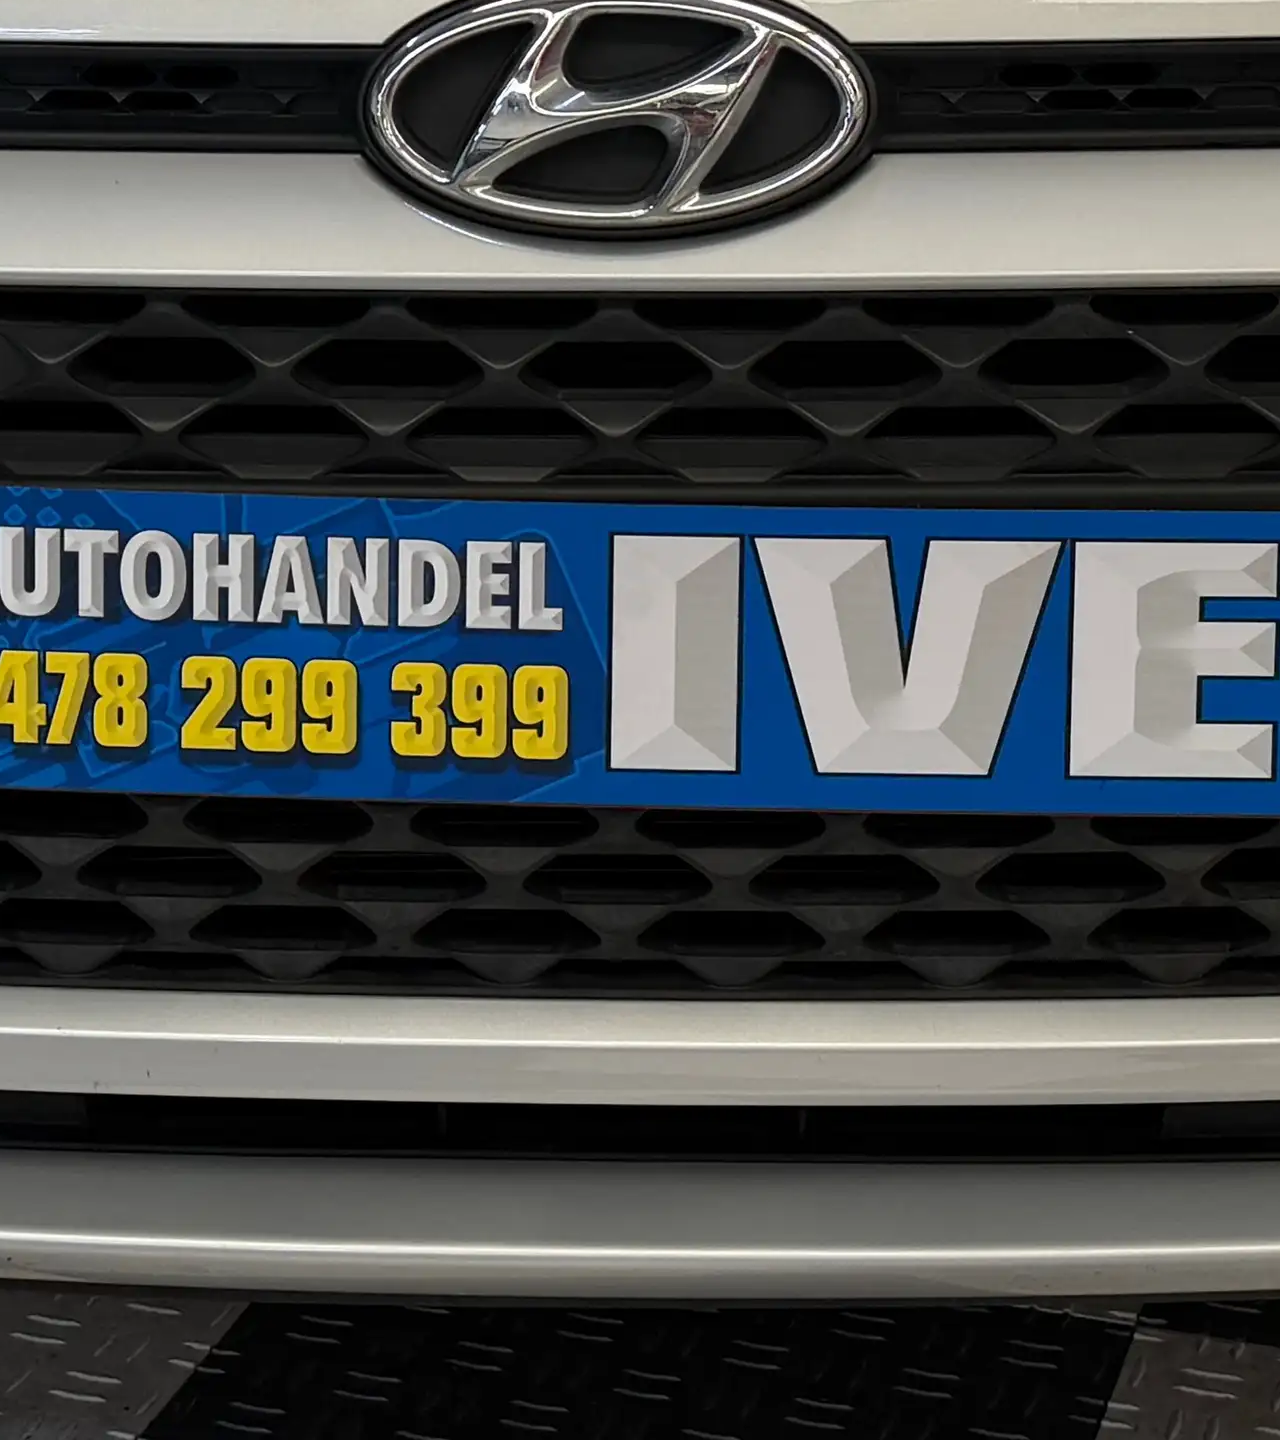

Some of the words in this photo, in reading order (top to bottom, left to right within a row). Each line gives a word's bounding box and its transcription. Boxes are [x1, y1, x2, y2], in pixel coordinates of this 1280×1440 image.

[180, 654, 359, 754] 299
[389, 660, 570, 760] 399
[607, 533, 1280, 779] IVE
